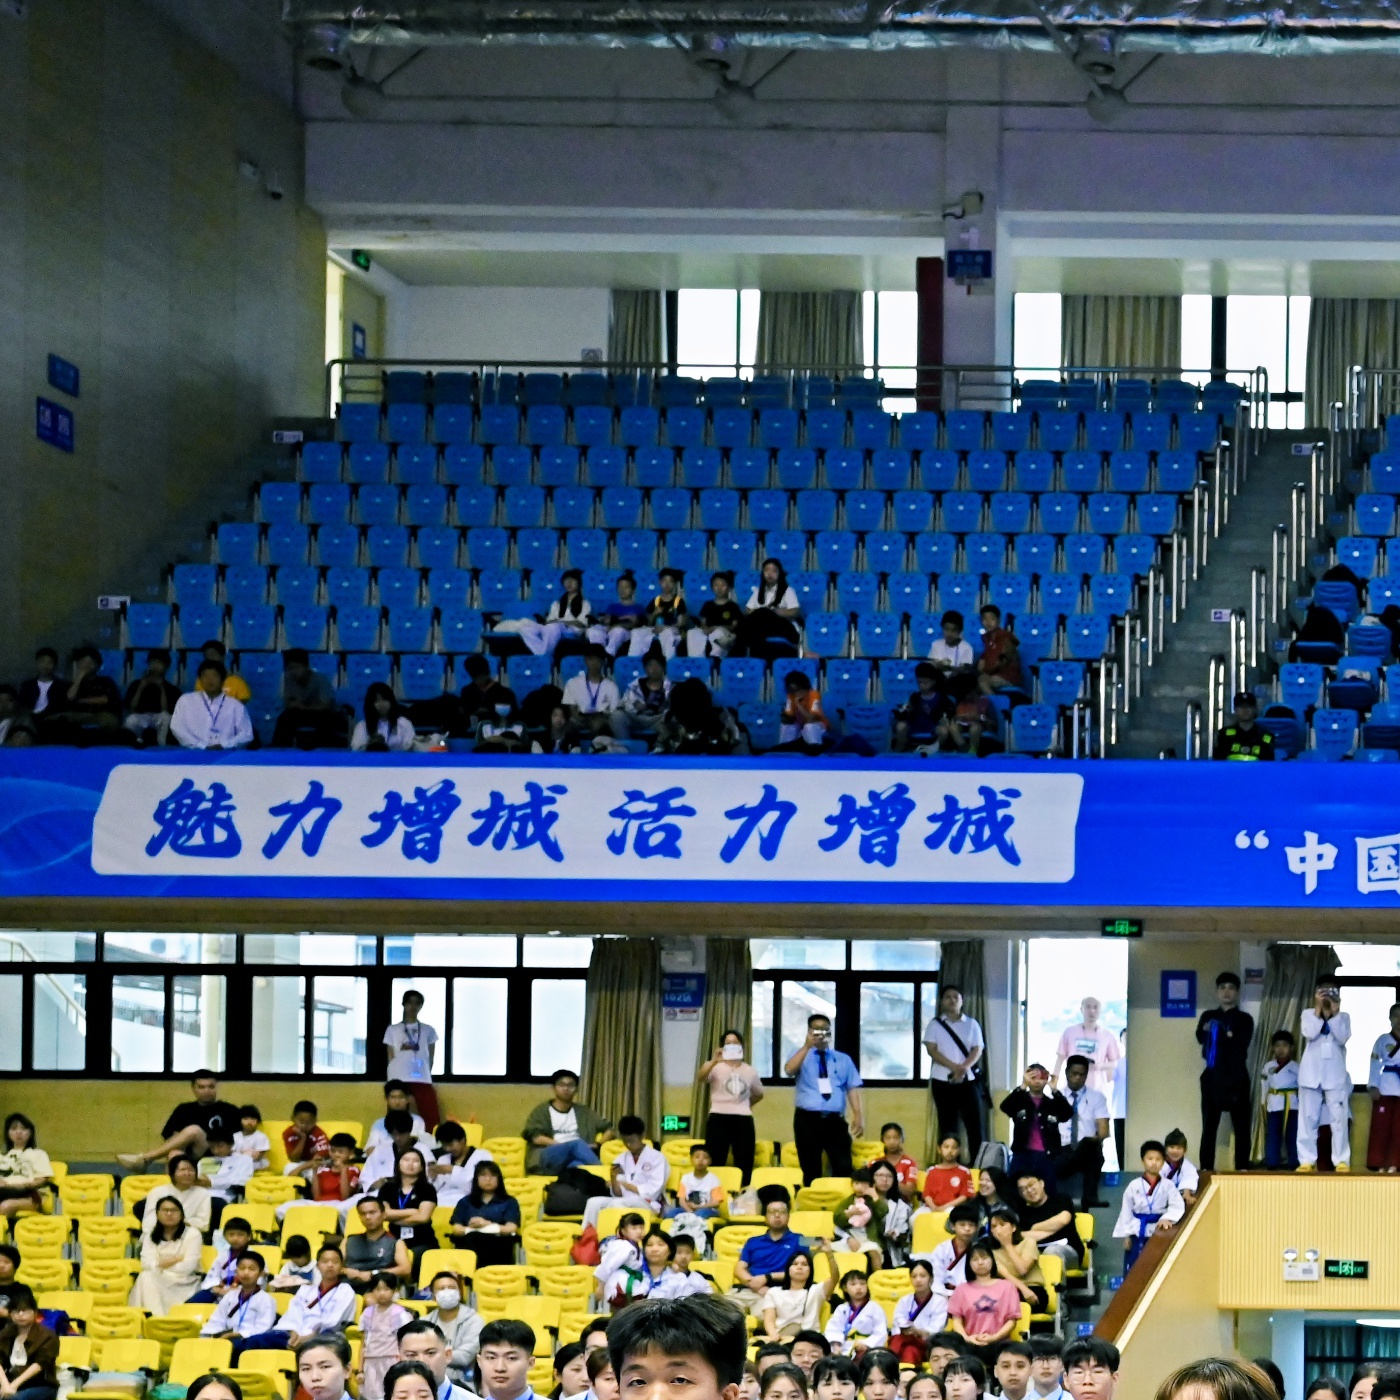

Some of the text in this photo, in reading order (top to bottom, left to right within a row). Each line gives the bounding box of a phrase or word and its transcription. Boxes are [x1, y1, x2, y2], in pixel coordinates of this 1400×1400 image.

[145, 776, 1023, 869] 魅力增城 活力增城
